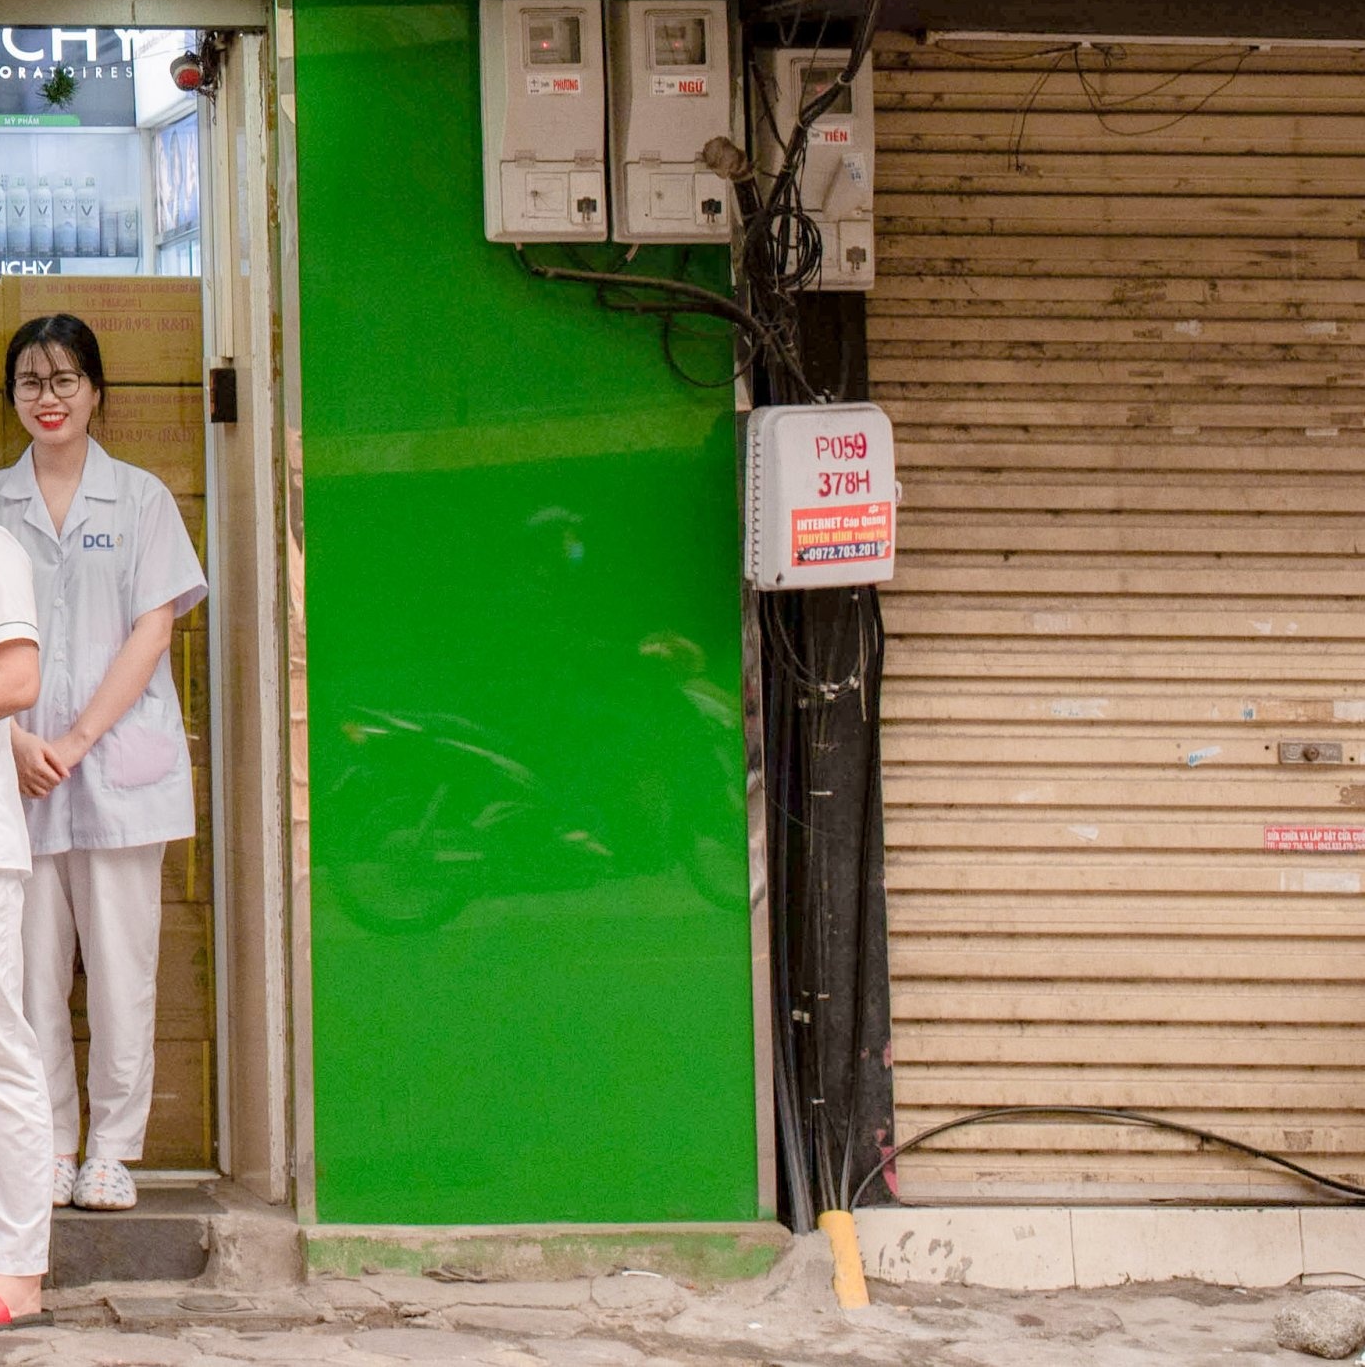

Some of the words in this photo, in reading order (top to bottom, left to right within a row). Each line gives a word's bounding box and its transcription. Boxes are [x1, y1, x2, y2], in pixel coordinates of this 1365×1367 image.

[815, 432, 868, 460] P059
[817, 469, 871, 498] 378H
[797, 517, 842, 531] INTERNET
[83, 533, 115, 549] DCL
[808, 542, 876, 561] 0972.703.201
